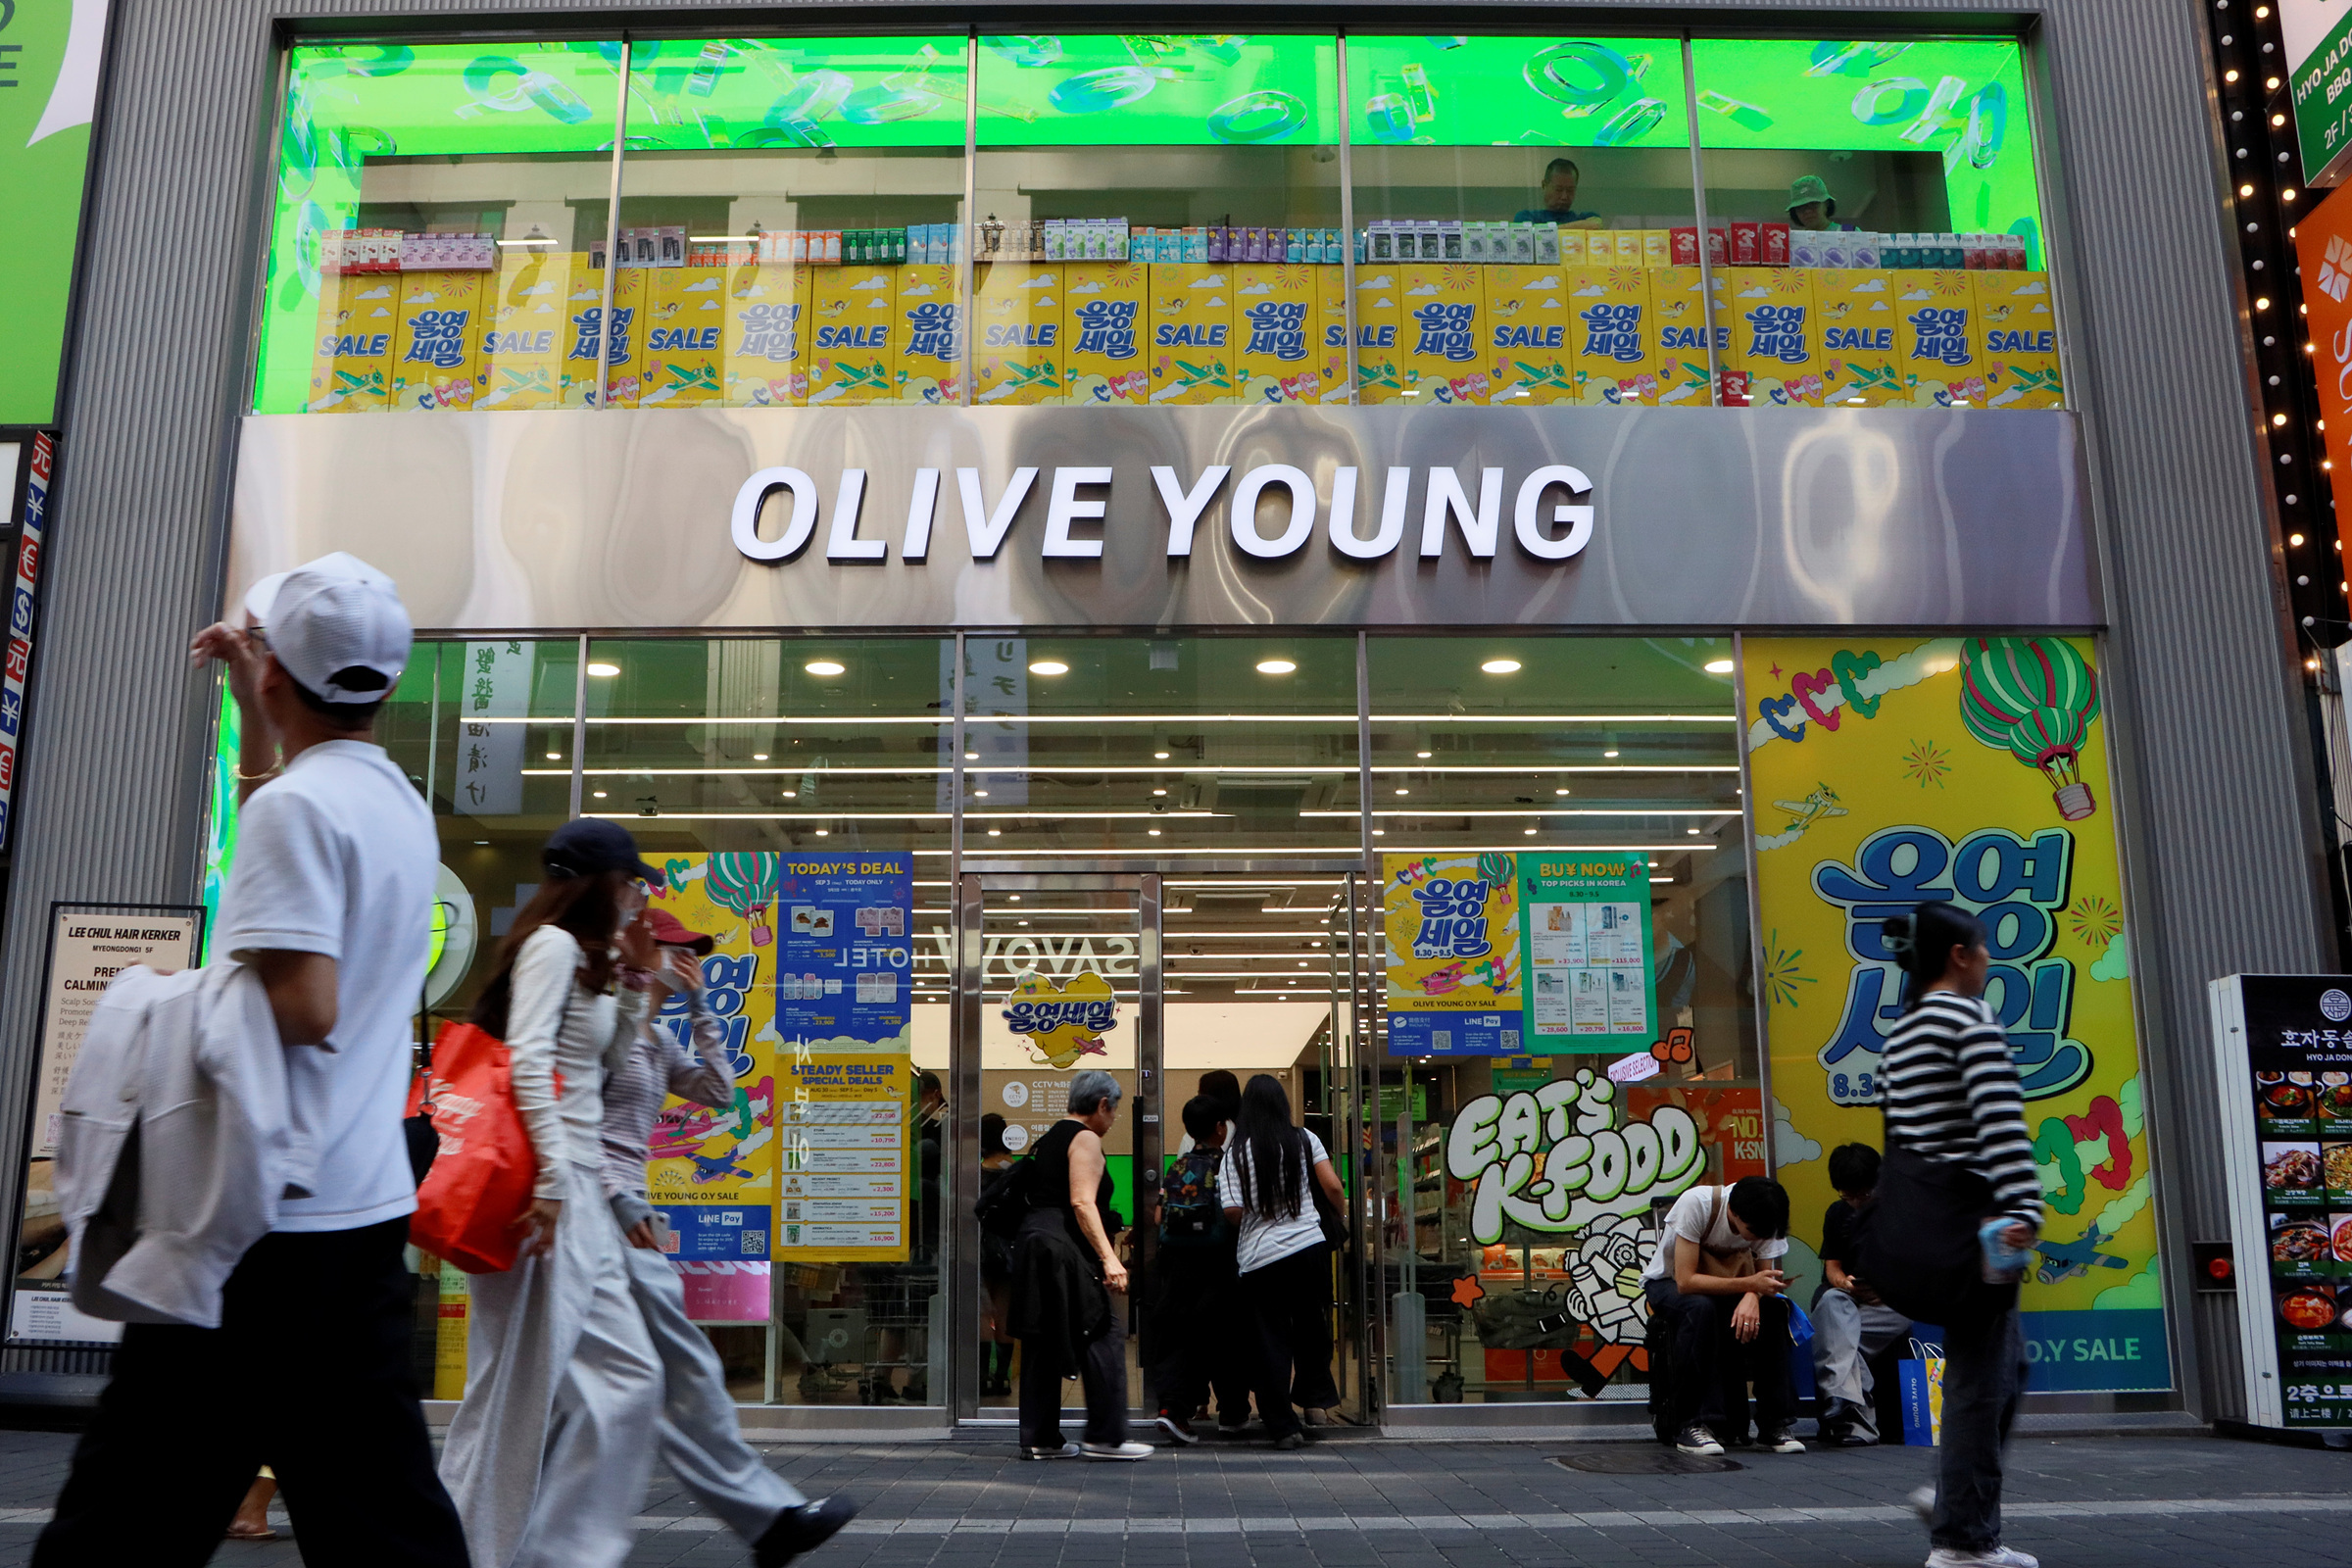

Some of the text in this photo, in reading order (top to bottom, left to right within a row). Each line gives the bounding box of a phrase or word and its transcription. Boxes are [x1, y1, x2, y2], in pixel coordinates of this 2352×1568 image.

[2296, 68, 2322, 106] HYO
[2324, 49, 2339, 76] JA
[2327, 68, 2352, 105] BBQ
[2325, 121, 2338, 150] 2F
[408, 308, 471, 341] 올영
[737, 302, 803, 334] 올영
[1074, 300, 1139, 332] 올영
[1245, 300, 1309, 332] 올영
[1411, 301, 1475, 333] 올영
[1579, 302, 1642, 335] 올영
[1744, 304, 1806, 336] 올영
[1906, 306, 1969, 338] 올영
[318, 333, 391, 358] SALE
[482, 330, 556, 355] SALE
[647, 326, 721, 351] SALE
[734, 330, 799, 363] 세일
[815, 324, 890, 349] SALE
[984, 323, 1058, 348] SALE
[1072, 328, 1139, 361] 세일
[1154, 323, 1229, 348] SALE
[1244, 329, 1309, 362] 세일
[1411, 330, 1476, 362] 세일
[1493, 324, 1565, 349] SALE
[1580, 331, 1645, 364] 세일
[1745, 332, 1810, 366] 세일
[1824, 326, 1894, 351] SALE
[1908, 334, 1971, 367] 세일
[1986, 329, 2056, 354] SALE
[402, 337, 467, 369] 세일
[730, 465, 1595, 565] OLIVE YOUNG
[788, 862, 904, 875] TODAY'S DEAL
[1411, 879, 1491, 918] 올영
[1811, 824, 2076, 967] 올영
[69, 927, 181, 941] LEE CHUL HAIR KERKER
[93, 945, 142, 954] MYEONGDONG1
[1412, 917, 1493, 959] 세일
[1414, 949, 1451, 957] 8.30 9.5
[64, 979, 111, 991] CALMIN
[61, 997, 80, 1007] Scalp
[1001, 1000, 1118, 1035] 올영세일
[59, 1018, 77, 1027] Deep
[791, 1064, 894, 1075] STEADY SELLER
[1609, 1054, 1657, 1082] EXCLUSIVE SELECTION
[1447, 1066, 1616, 1180] EAT'S
[1471, 1104, 1707, 1246] K-FOOD
[698, 1214, 740, 1224] LINE Pay
[2074, 1338, 2141, 1361] SALE
[1912, 1398, 1921, 1429] YOUNG
